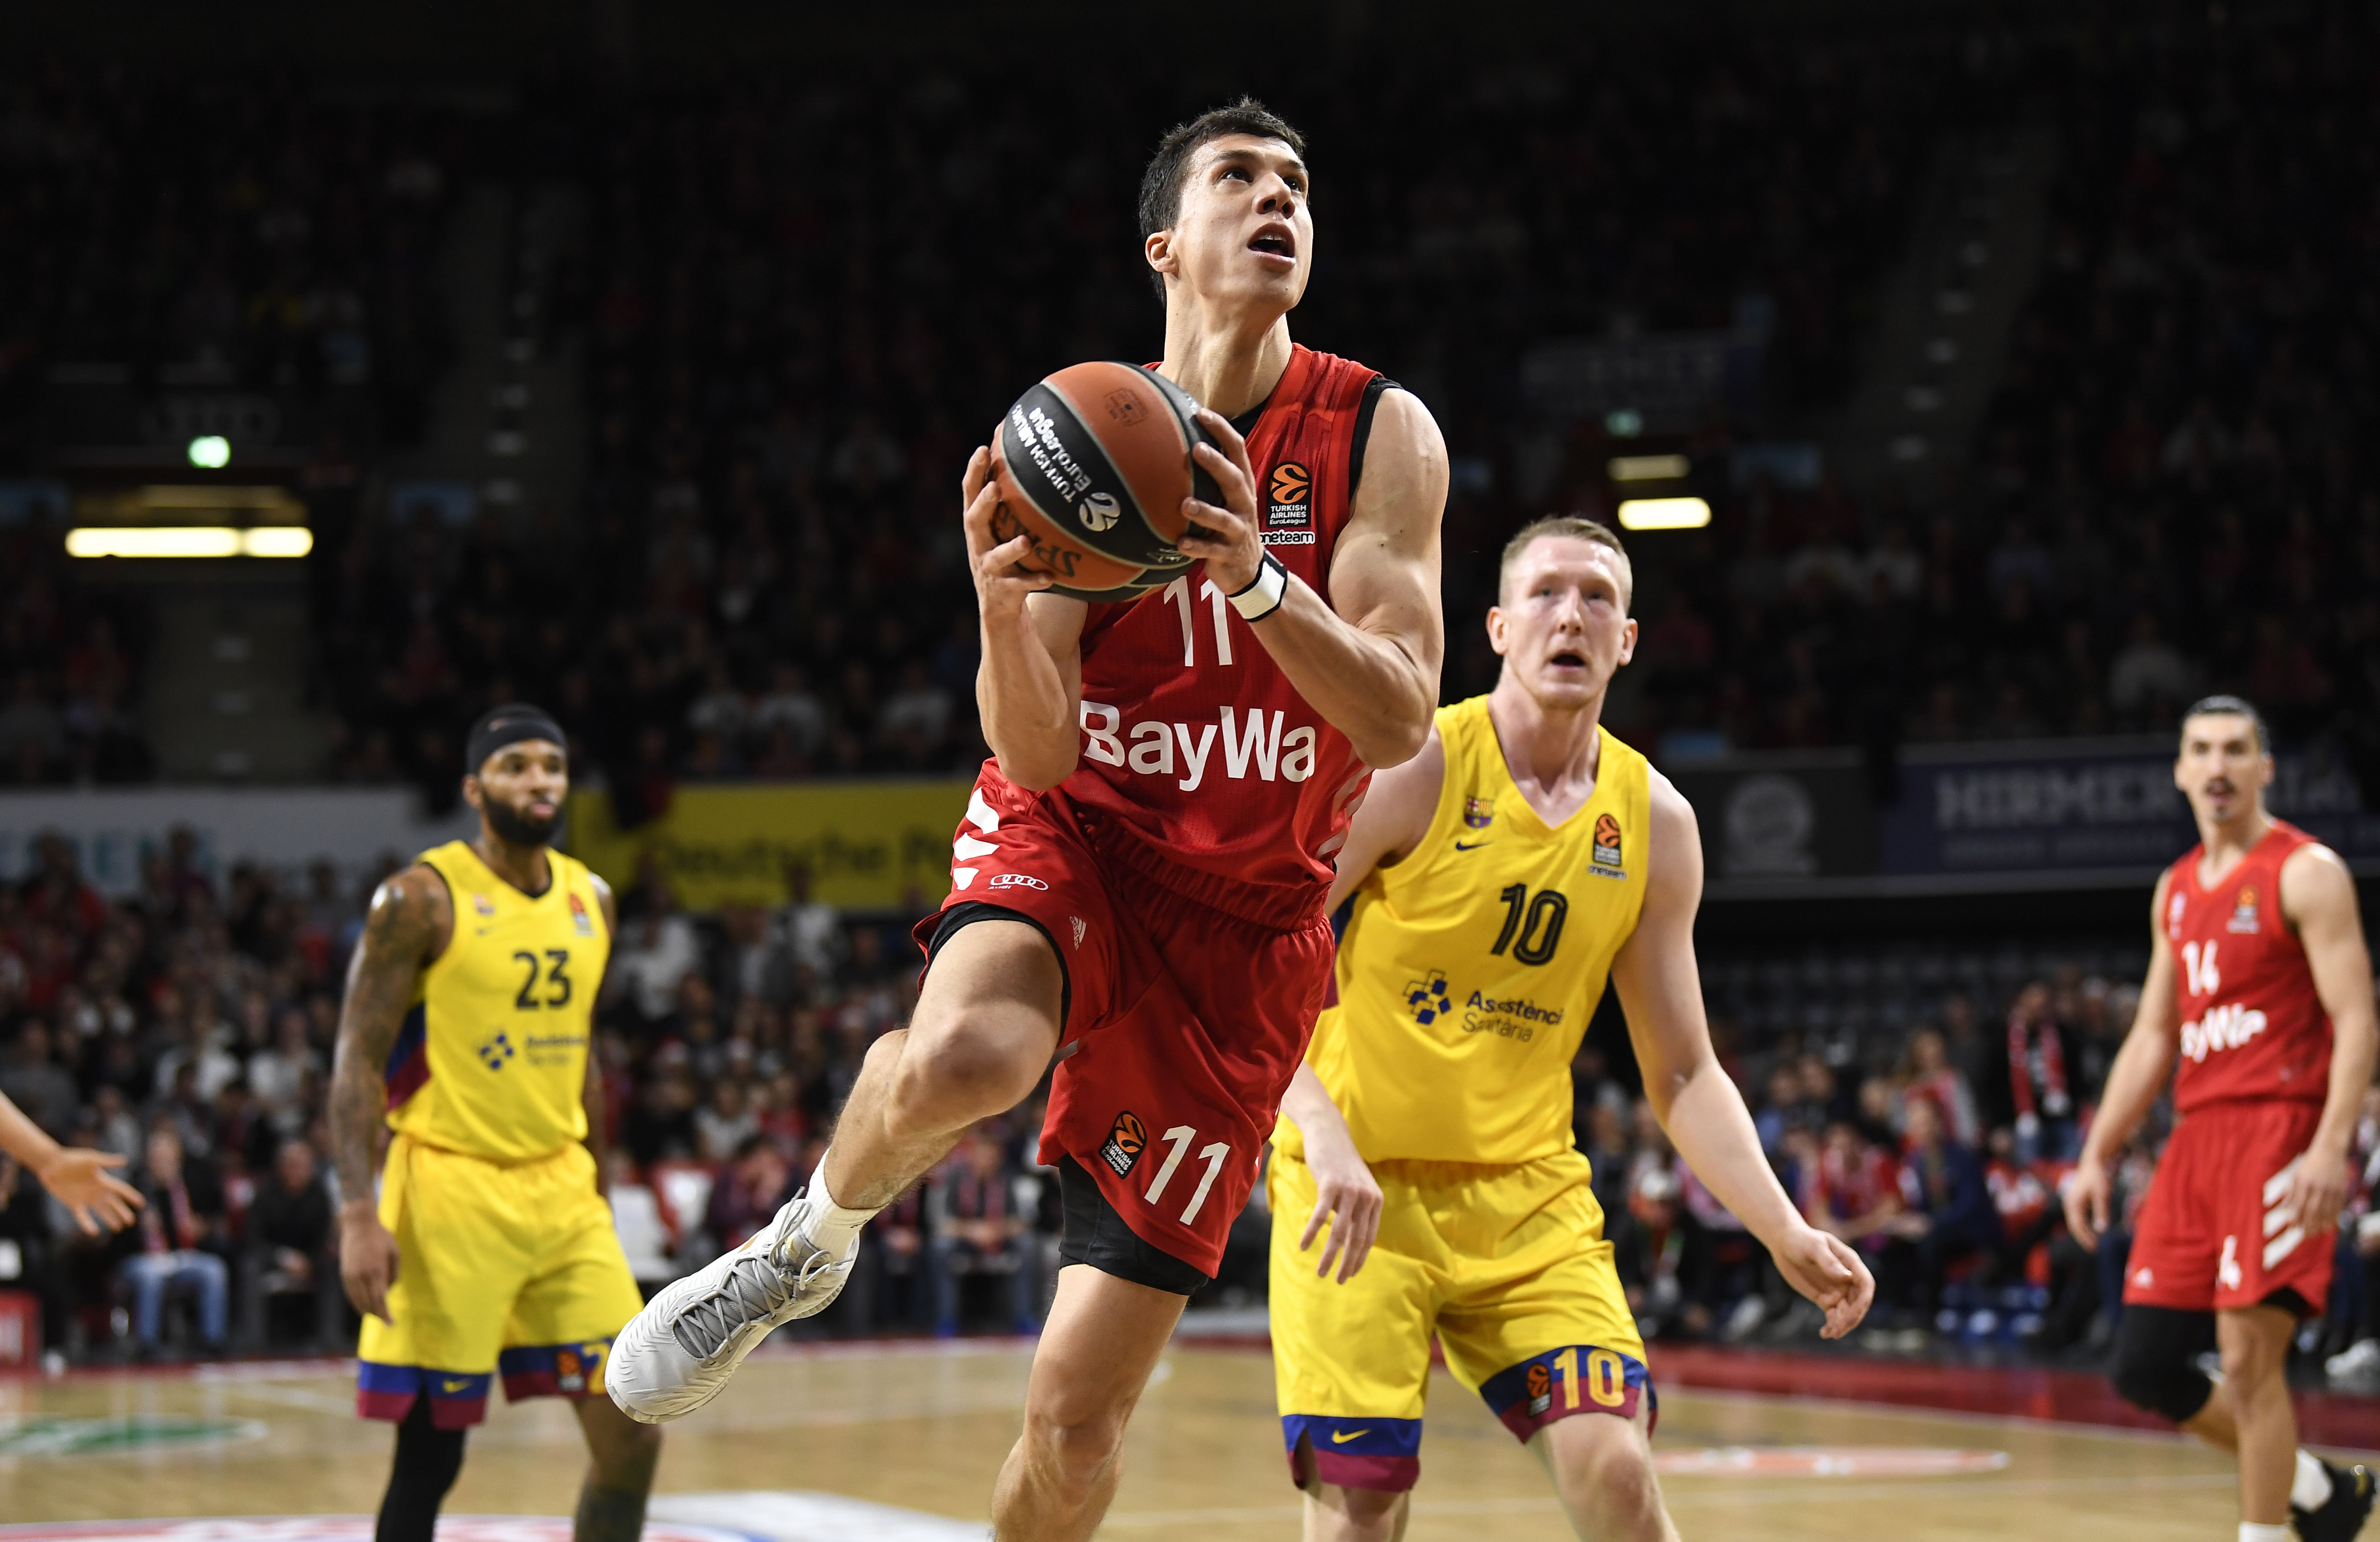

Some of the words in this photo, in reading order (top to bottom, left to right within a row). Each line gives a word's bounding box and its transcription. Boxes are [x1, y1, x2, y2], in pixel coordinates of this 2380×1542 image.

[1029, 407, 1092, 492] EuroLeague
[1030, 444, 1076, 503] TURKISH
[1164, 575, 1232, 667] 11
[1080, 700, 1316, 791] BayWa
[1070, 916, 1079, 951] adidas
[1490, 883, 1568, 967] 10
[513, 949, 572, 1011] 23
[1105, 1146, 1129, 1170] AIRLINES
[1109, 1139, 1132, 1166] TURKISH
[1144, 1125, 1231, 1225] 11
[583, 1343, 611, 1395] 2
[1554, 1346, 1625, 1410] 10
